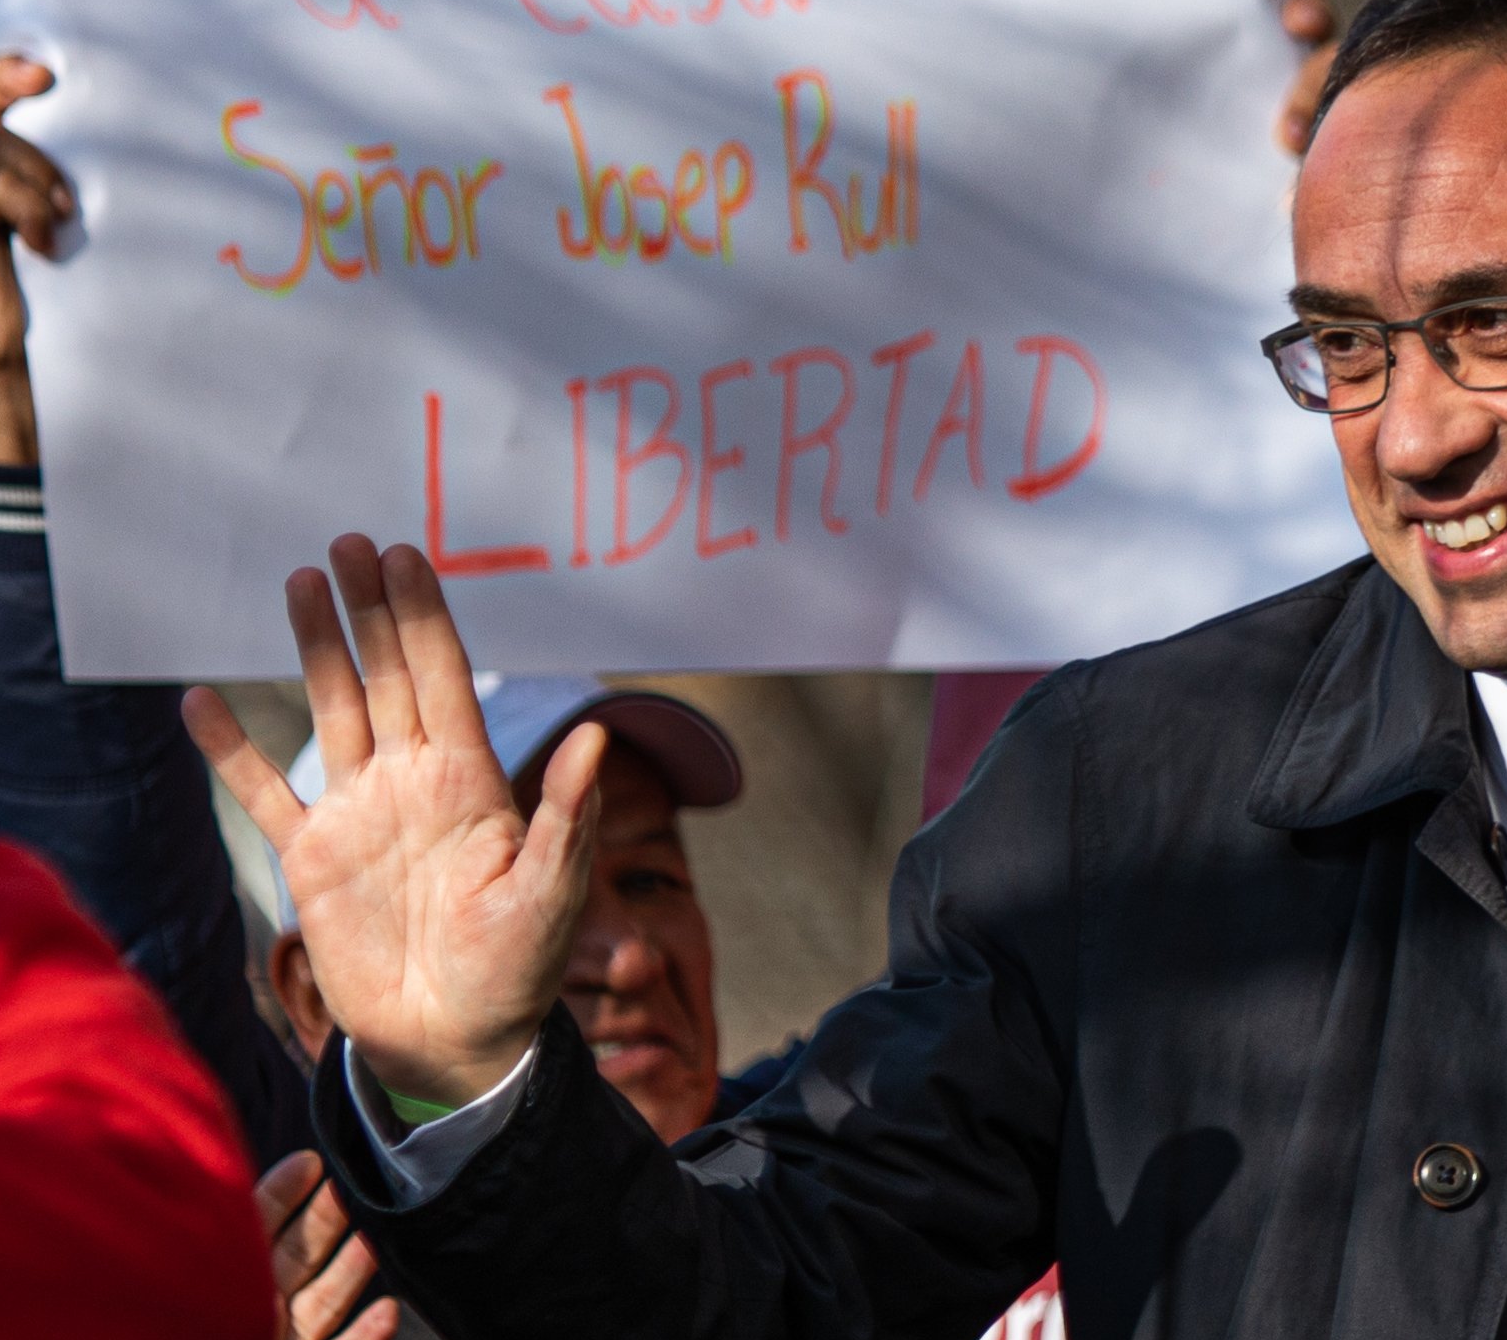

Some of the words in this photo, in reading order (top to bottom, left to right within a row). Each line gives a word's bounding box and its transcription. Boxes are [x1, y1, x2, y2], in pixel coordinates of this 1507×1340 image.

[219, 98, 503, 294] Señor
[542, 83, 755, 266] Josep
[775, 66, 920, 261] Rull
[423, 331, 1108, 580] LIBERTAD
